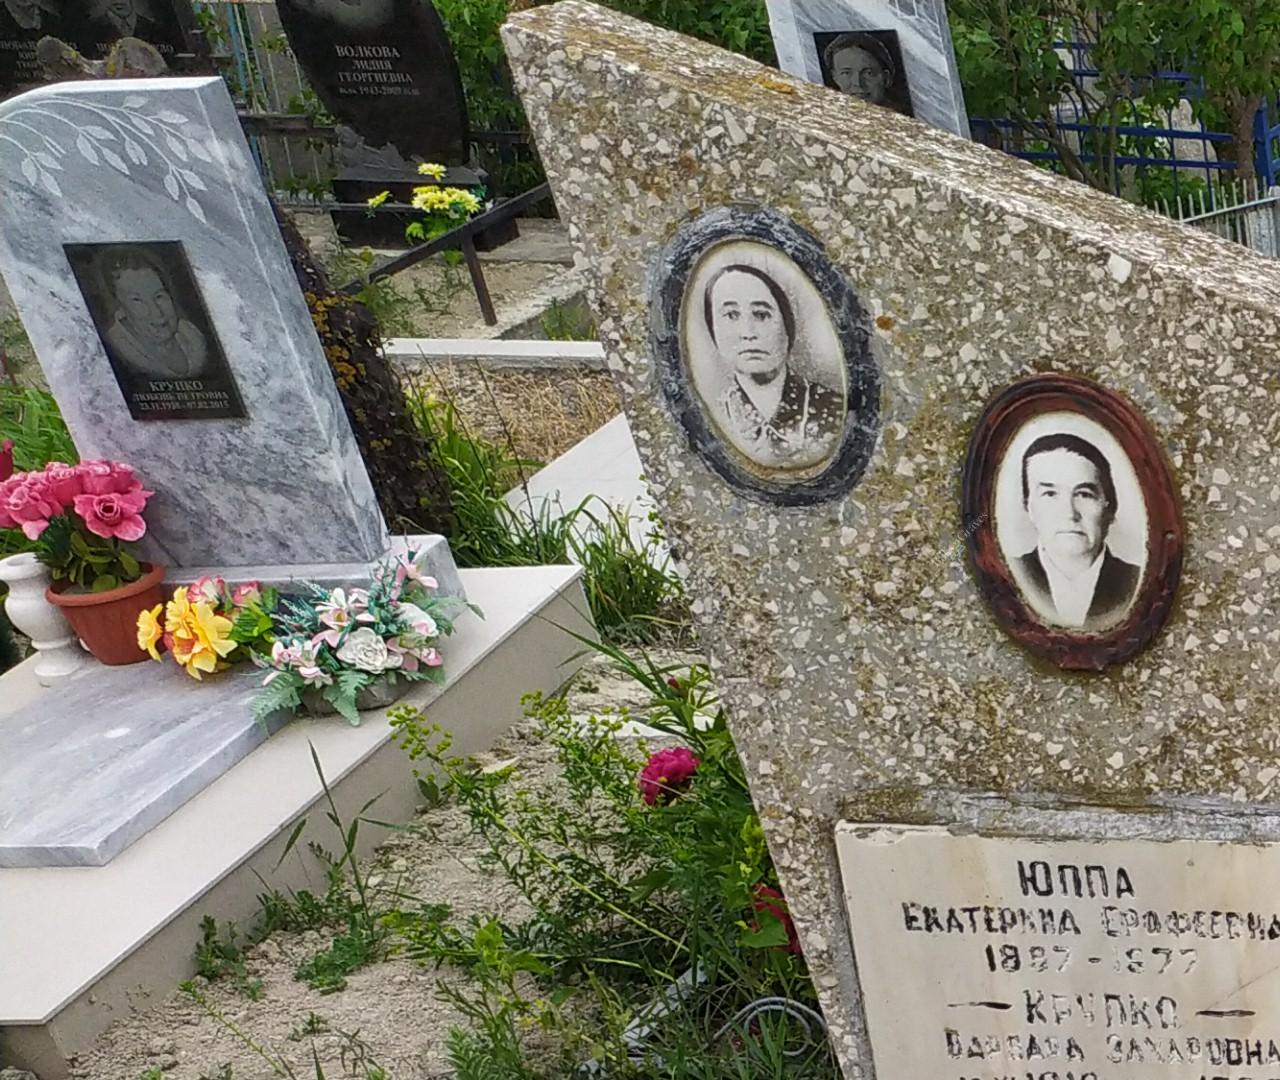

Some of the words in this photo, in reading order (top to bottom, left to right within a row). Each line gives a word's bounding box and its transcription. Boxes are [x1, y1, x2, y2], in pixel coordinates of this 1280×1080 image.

[336, 45, 400, 58] ВОЛКОВА
[338, 72, 413, 82] ГЕОРГИЕВНА
[149, 381, 204, 392] КРУПКО
[1017, 860, 1136, 898] ЮППА
[902, 901, 1081, 935] ЕКАТЕРИНА
[1023, 990, 1181, 1029] КРУПКО
